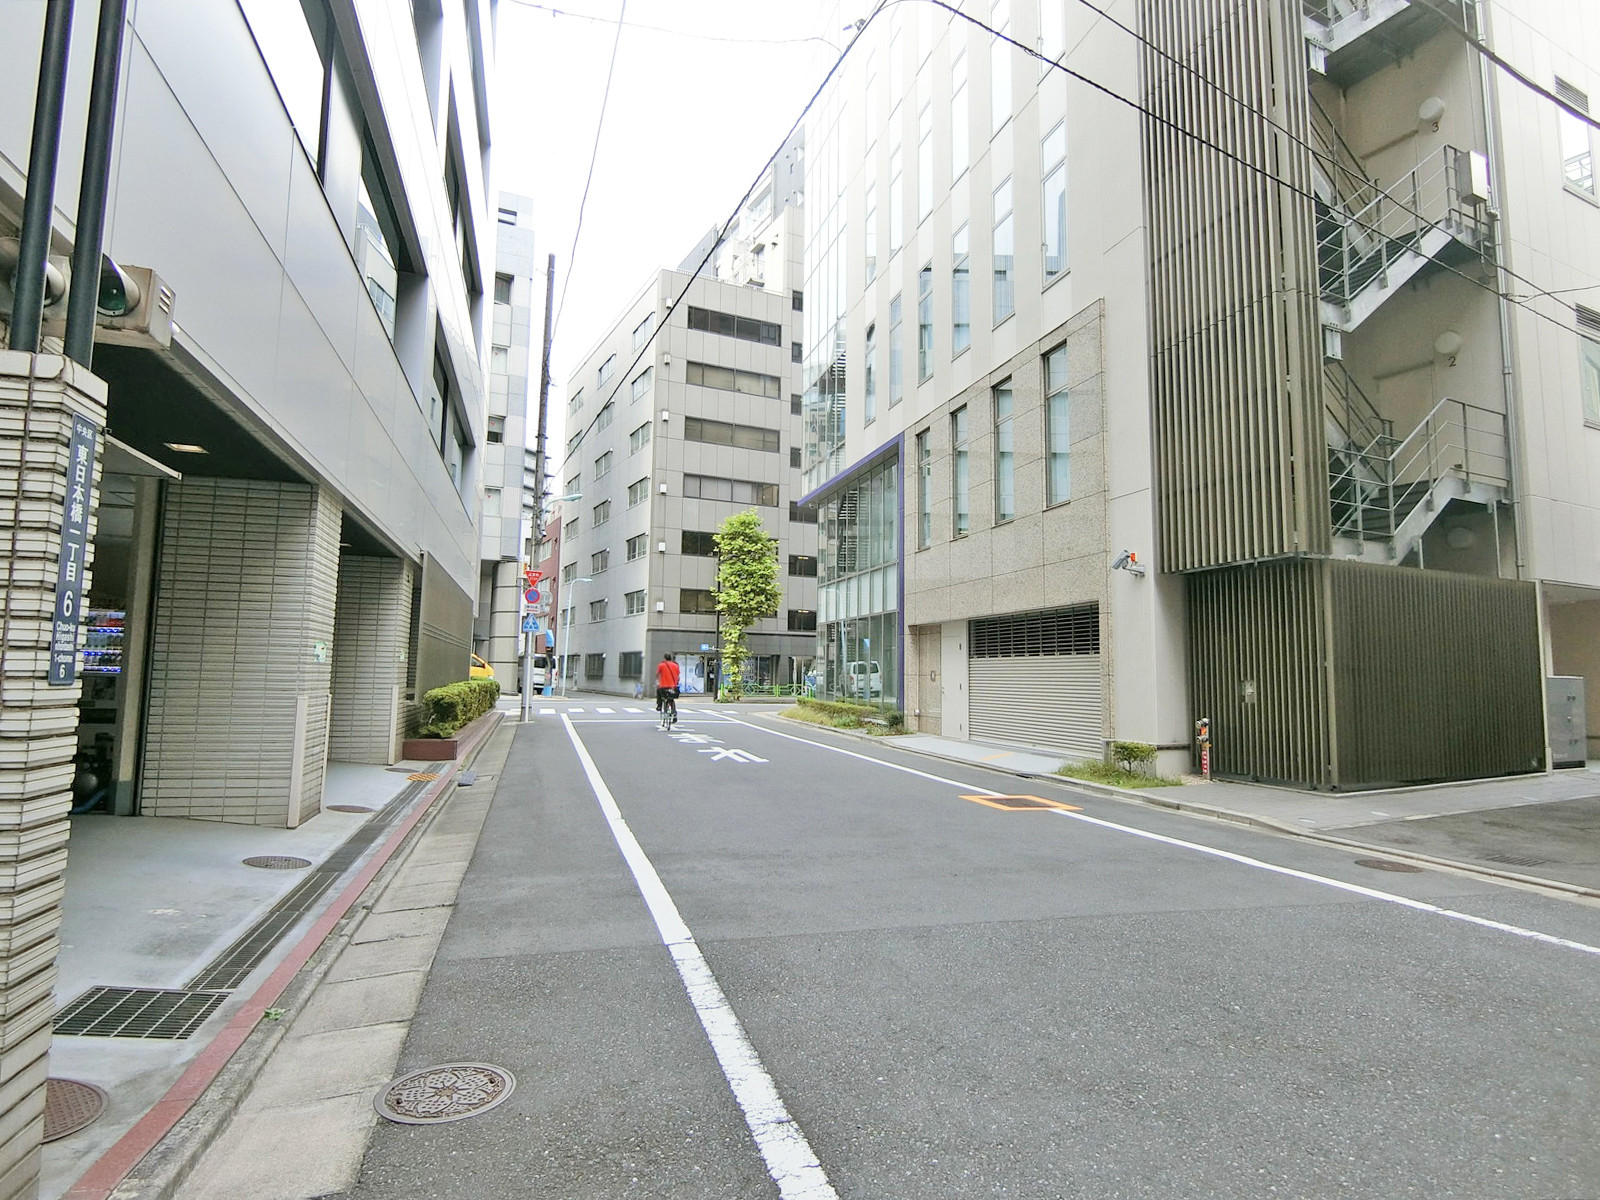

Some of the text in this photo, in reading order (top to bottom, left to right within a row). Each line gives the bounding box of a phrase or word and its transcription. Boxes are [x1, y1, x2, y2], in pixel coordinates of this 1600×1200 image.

[1431, 121, 1439, 133] 3
[1448, 355, 1457, 368] 2
[75, 423, 94, 440] 中央区
[63, 590, 74, 617] 6
[59, 664, 66, 678] 6
